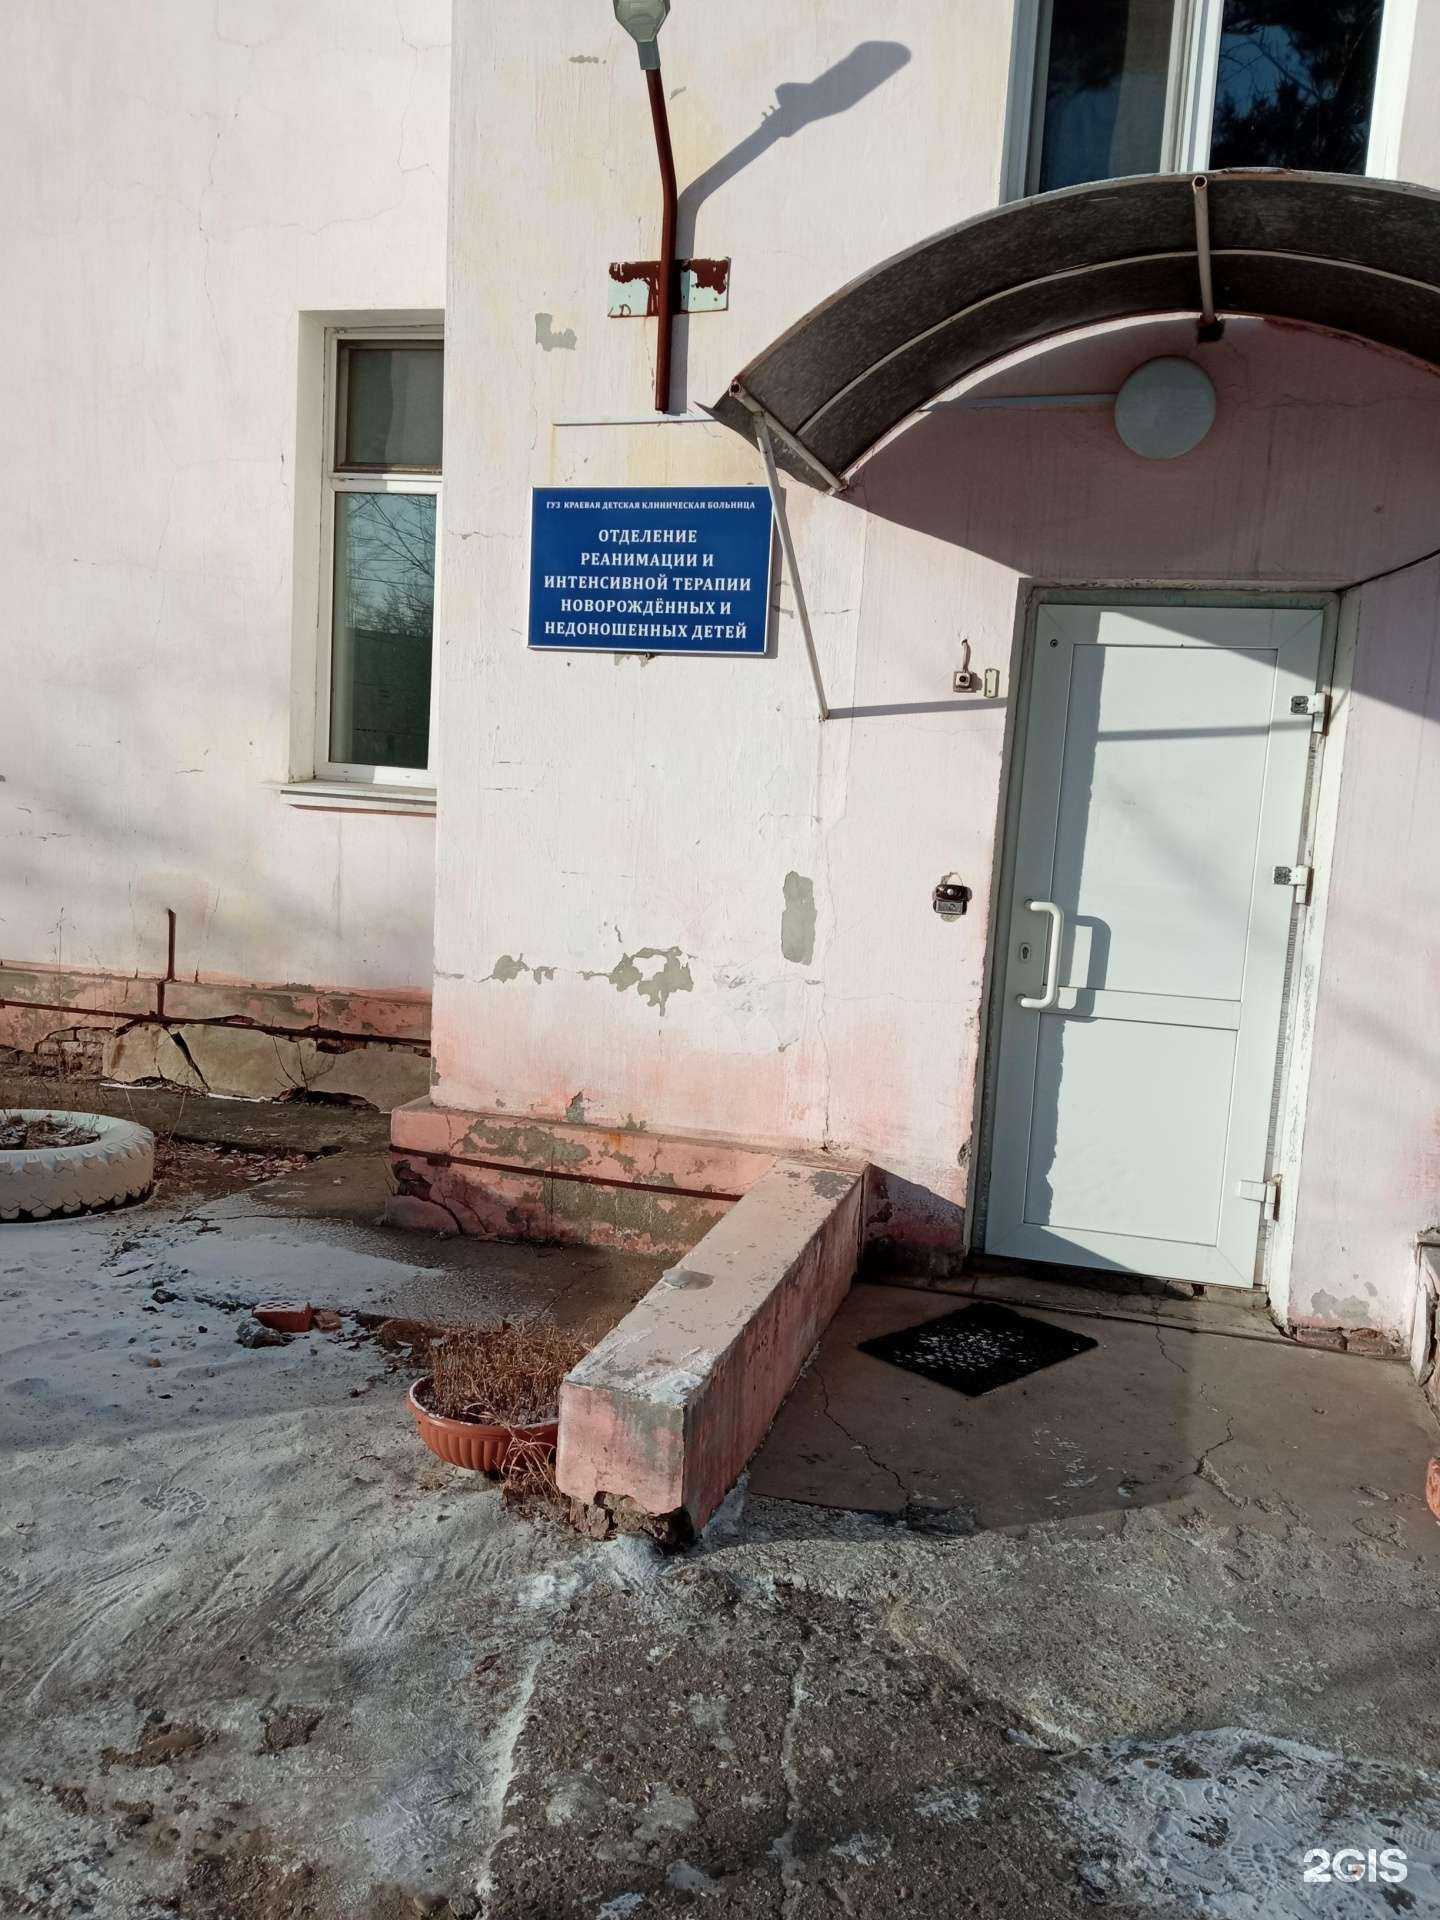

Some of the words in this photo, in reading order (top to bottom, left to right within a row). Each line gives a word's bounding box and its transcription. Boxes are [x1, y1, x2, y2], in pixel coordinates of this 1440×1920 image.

[602, 502, 640, 510] ДЕТСКАЯ
[707, 502, 755, 510] БОЛЬНИЦА
[599, 529, 697, 545] ОТДЕЛЕНИЕ
[581, 553, 697, 569] РЕАНИМАЦИИ
[703, 554, 714, 567] И
[544, 574, 668, 590] ИНТЕНСИВНОЙ
[673, 577, 751, 591] ТЕРАПИИ
[561, 599, 715, 615] НОВОРОЖДЁННЫХ
[720, 602, 731, 614] И
[545, 622, 687, 638] НЕДОНОШЕННЫХ
[692, 622, 747, 640] ДЕТЕЙ
